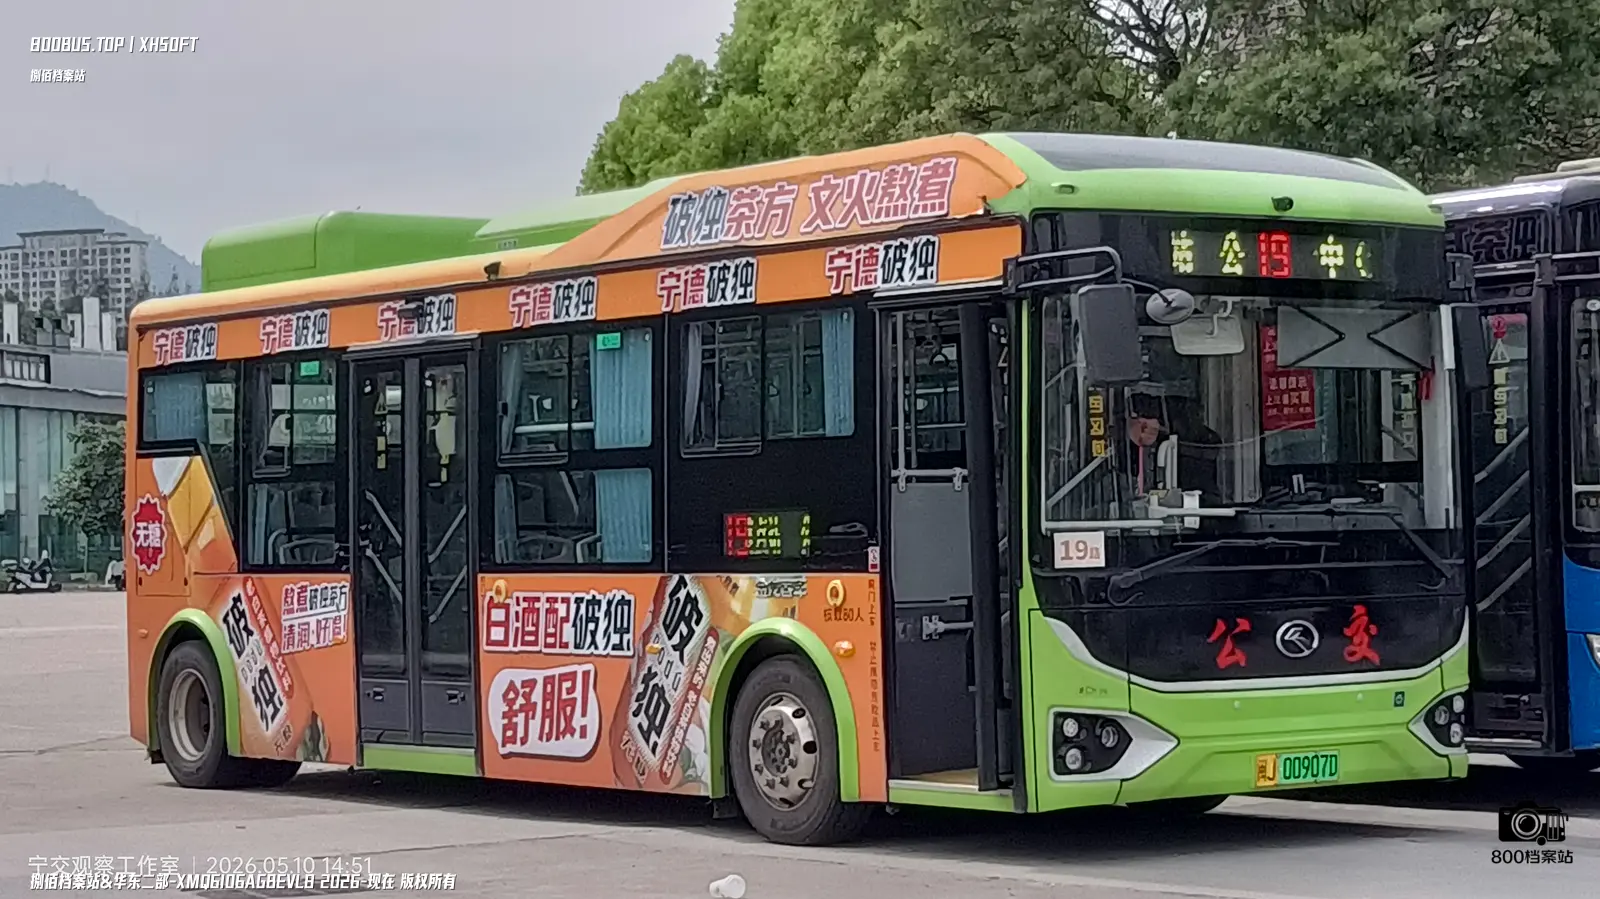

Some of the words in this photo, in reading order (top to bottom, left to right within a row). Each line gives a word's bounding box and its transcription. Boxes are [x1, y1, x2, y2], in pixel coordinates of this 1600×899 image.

[662, 183, 797, 250] 破独茶方
[801, 158, 957, 233] 文火熬煮
[825, 236, 939, 294] 宁德破独
[1257, 231, 1292, 278] 19
[509, 276, 597, 328] 宁德破独
[657, 257, 757, 314] 宁德破独
[154, 323, 218, 364] 宁德破独
[260, 309, 331, 354] 宁德破独
[135, 521, 162, 548] 无糖
[485, 591, 633, 654] 白酒配破独
[1206, 618, 1251, 669] 公
[1342, 604, 1381, 666] 交
[501, 668, 592, 750] 舒服!
